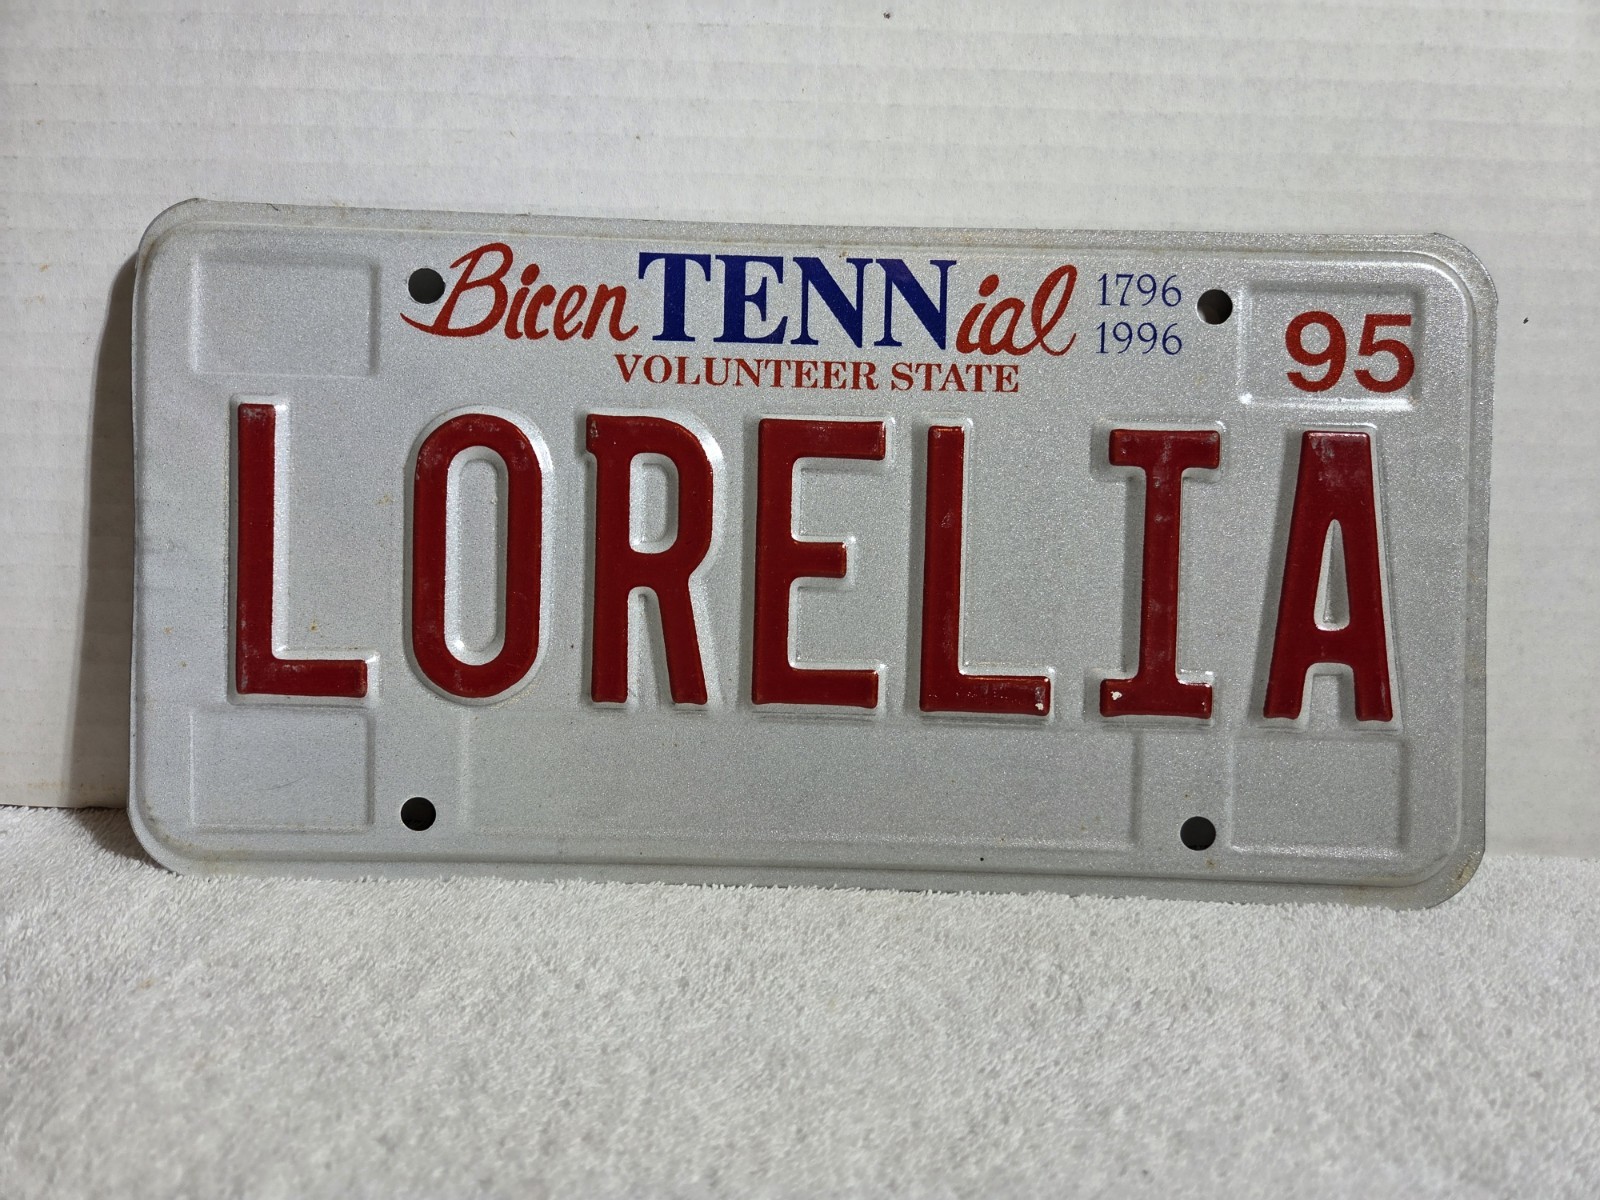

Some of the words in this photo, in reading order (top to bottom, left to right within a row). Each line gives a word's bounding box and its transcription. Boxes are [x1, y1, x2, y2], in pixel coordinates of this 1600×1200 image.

[401, 242, 1078, 356] BicenTENNial
[1098, 273, 1182, 308] 1796
[1096, 322, 1183, 357] 1996
[1285, 311, 1415, 393] 95
[614, 353, 878, 391] VOLUNTEER
[891, 363, 1019, 394] STATE
[236, 403, 1394, 722] LORELIA
